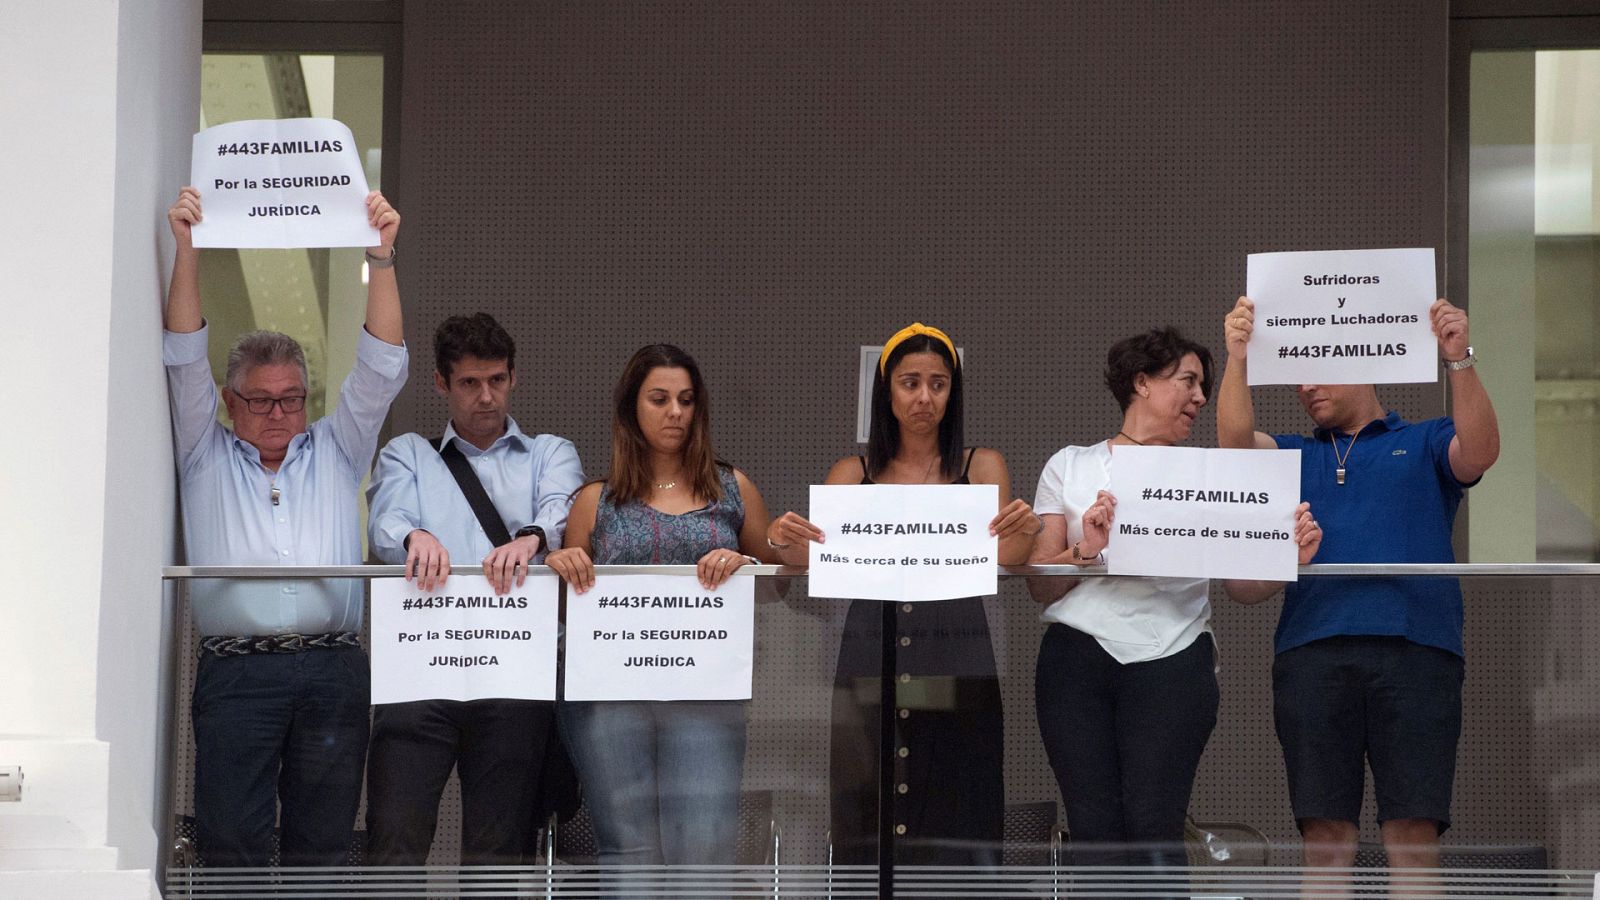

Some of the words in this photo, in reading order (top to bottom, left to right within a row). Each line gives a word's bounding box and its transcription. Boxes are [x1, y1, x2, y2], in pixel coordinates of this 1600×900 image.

[217, 140, 343, 156] #443FAMILIAS
[214, 178, 240, 190] Por
[244, 178, 257, 189] la
[262, 175, 351, 189] SEGURIDAD
[248, 204, 321, 217] JURÍDICA
[1303, 274, 1380, 286] Sufridoras
[1337, 297, 1346, 308] y
[1266, 316, 1326, 328] siempre
[1331, 313, 1419, 325] Luchadoras
[1278, 343, 1407, 359] #443FAMILIAS
[1142, 488, 1269, 505] #443FAMILIAS
[841, 523, 968, 535] #443FAMILIAS
[1119, 524, 1149, 536] Más
[1154, 527, 1196, 537] cerca
[1200, 527, 1219, 538] de
[1223, 530, 1240, 539] su
[1245, 530, 1290, 541] sueño
[820, 553, 849, 564] Más
[854, 557, 896, 566] cerca
[900, 556, 918, 566] de
[923, 557, 940, 566] su
[945, 555, 989, 566] sueño
[402, 596, 528, 611] #443FAMILIAS
[598, 596, 724, 609] #443FAMILIAS
[398, 632, 423, 643] Por
[427, 630, 440, 641] la
[444, 629, 532, 641] SEGURIDAD
[593, 630, 618, 641] Por
[622, 630, 635, 640] la
[640, 630, 728, 641] SEGURIDAD
[428, 655, 499, 668] JURÍDICA
[623, 654, 696, 668] JURÍDICA
